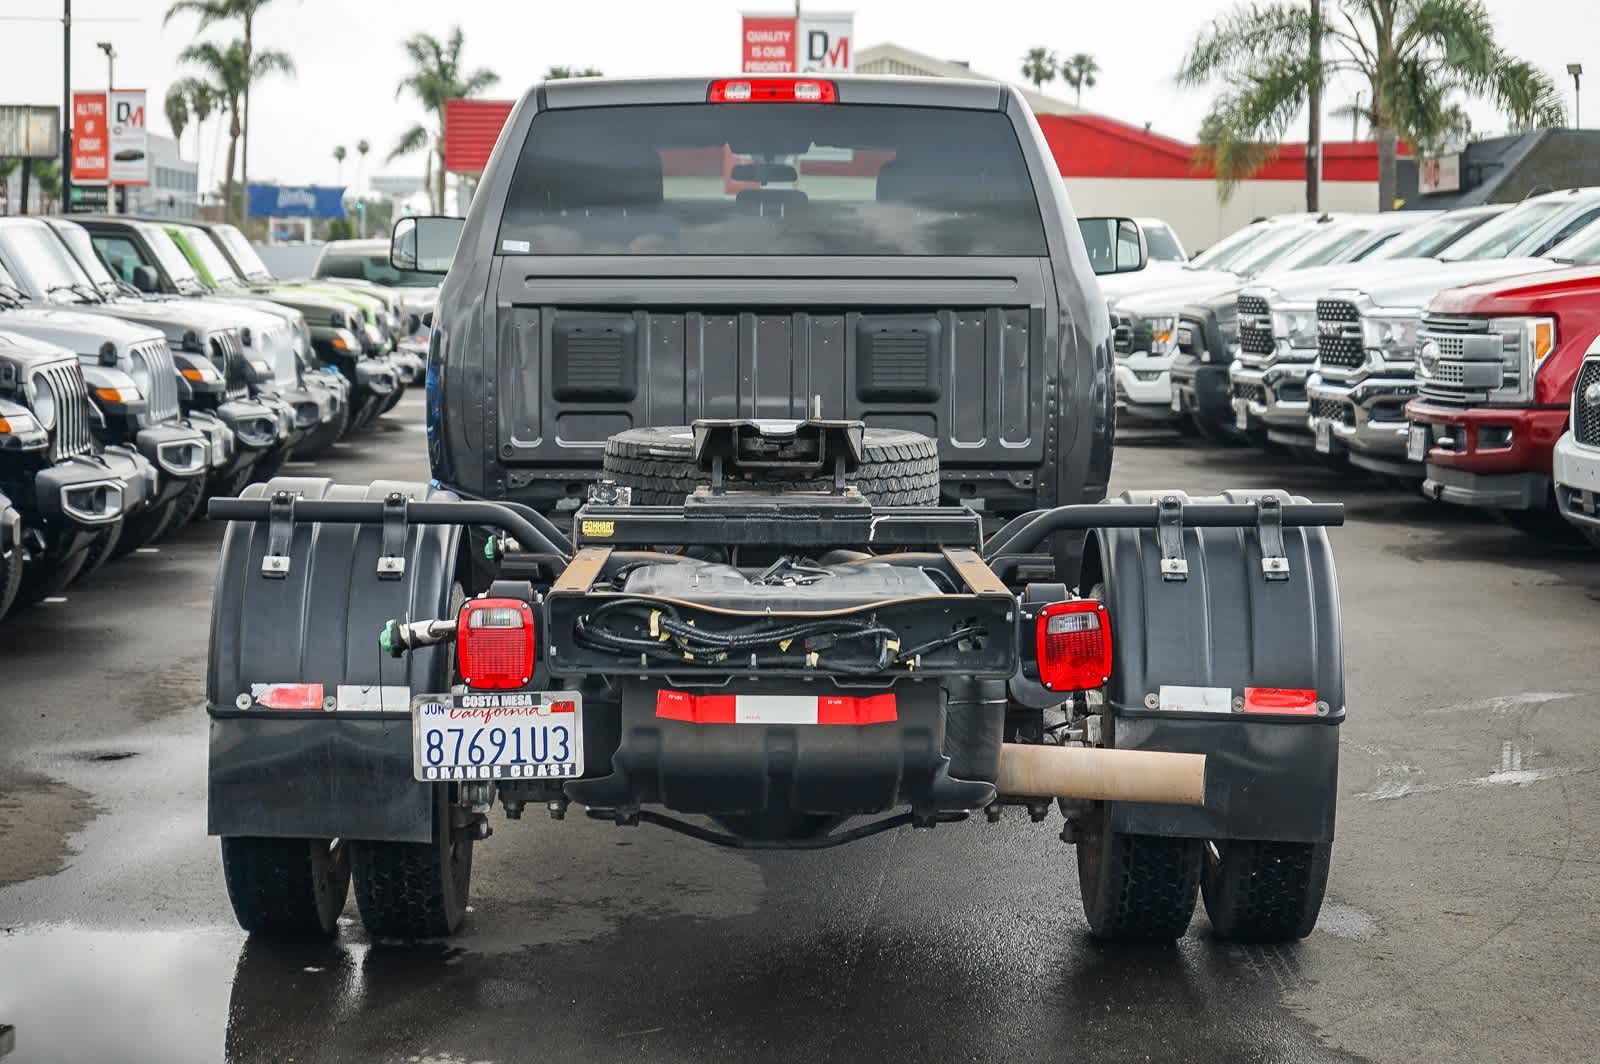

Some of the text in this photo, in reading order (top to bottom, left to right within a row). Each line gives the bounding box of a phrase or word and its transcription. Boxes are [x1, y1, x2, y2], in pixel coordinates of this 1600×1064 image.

[746, 31, 791, 42] QUALITY
[752, 47, 785, 57] IS OUR
[808, 30, 849, 69] DM
[744, 62, 792, 73] PRIORITY
[117, 102, 144, 128] DM
[462, 695, 533, 708] COSTA MESA
[424, 704, 445, 715] JUN
[426, 726, 570, 766] 87691U3
[426, 764, 573, 780] ORANGE COAST
